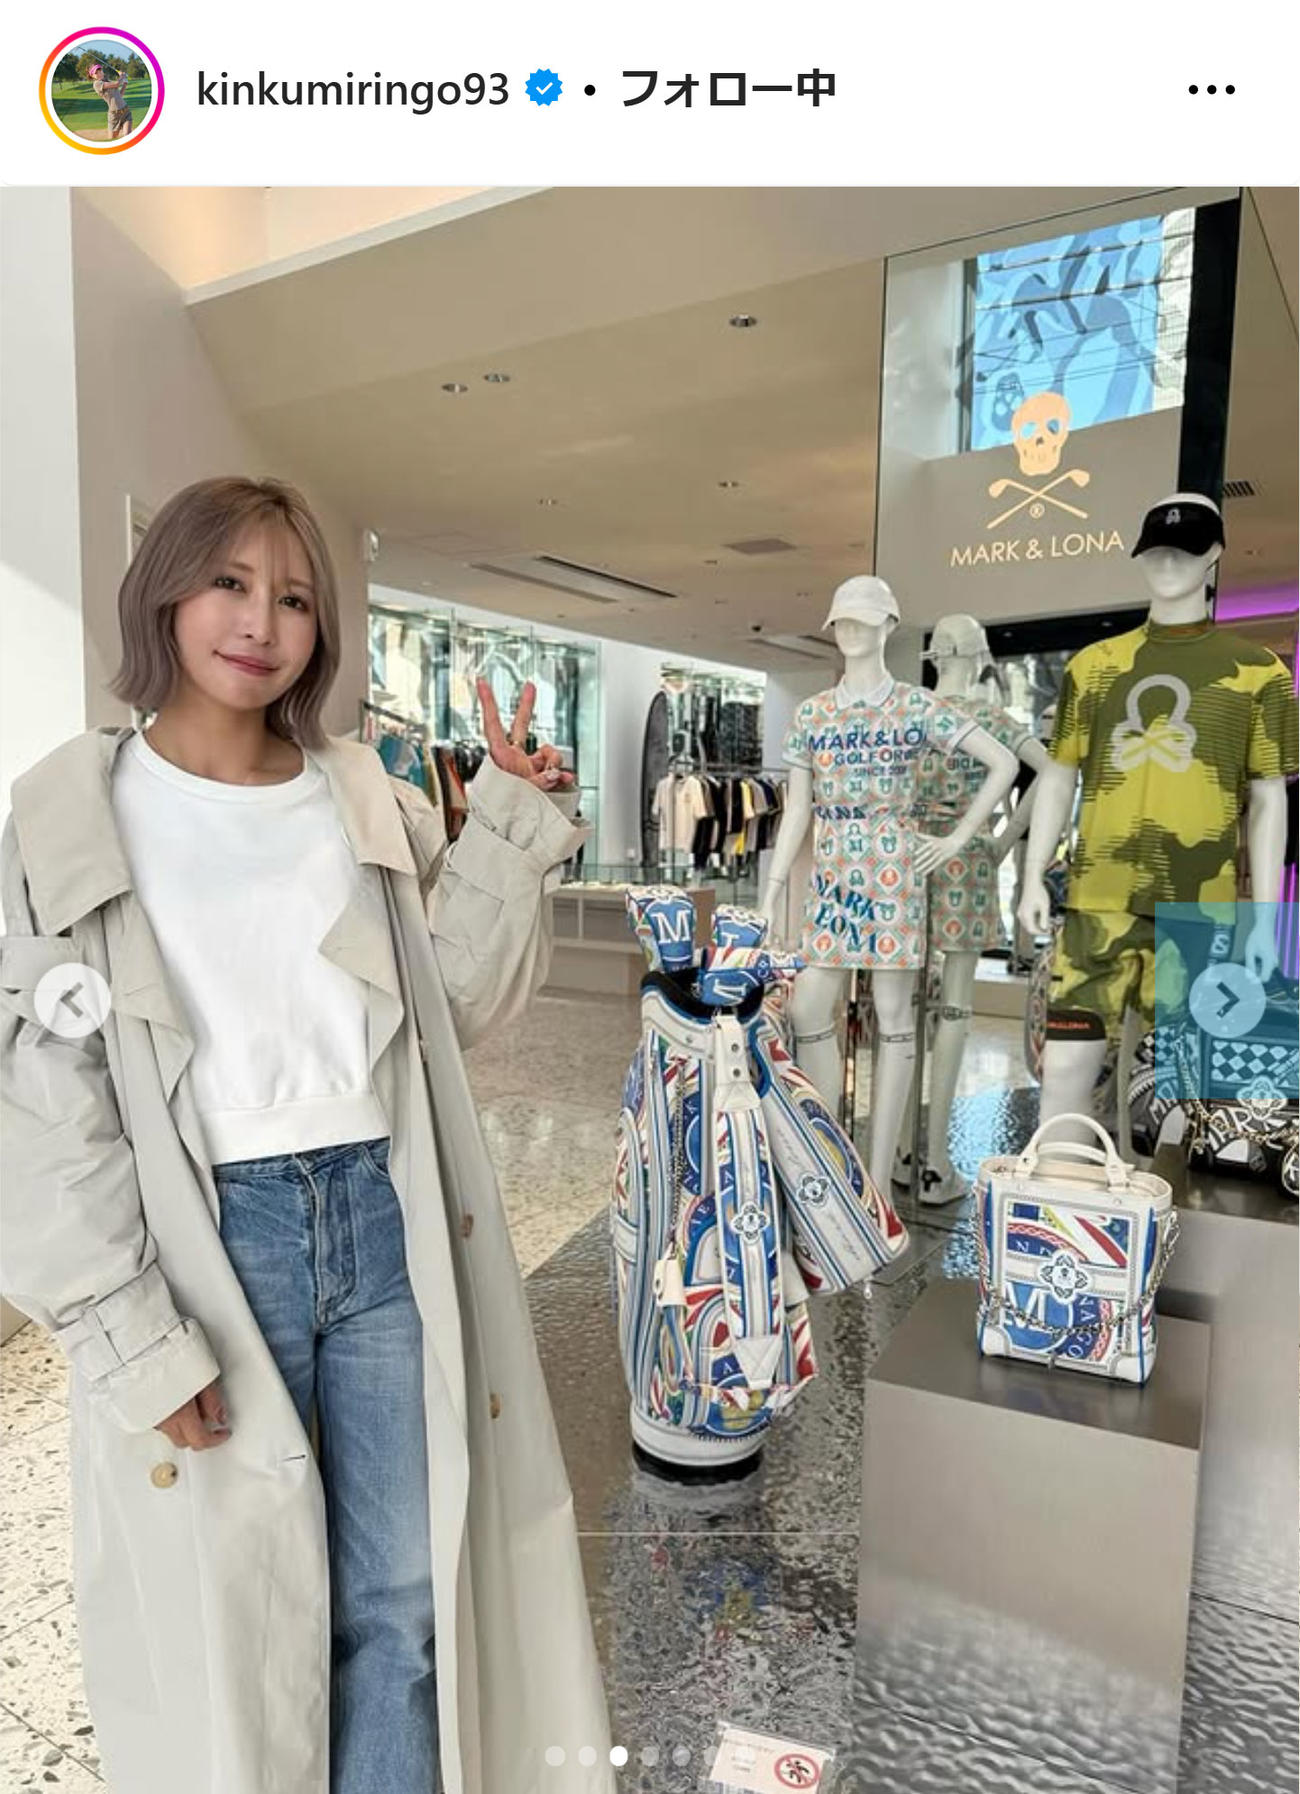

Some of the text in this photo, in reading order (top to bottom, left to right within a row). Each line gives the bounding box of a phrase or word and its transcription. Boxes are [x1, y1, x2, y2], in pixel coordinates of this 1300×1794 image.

[950, 530, 1125, 568] MARK & LONA
[650, 910, 691, 944] M
